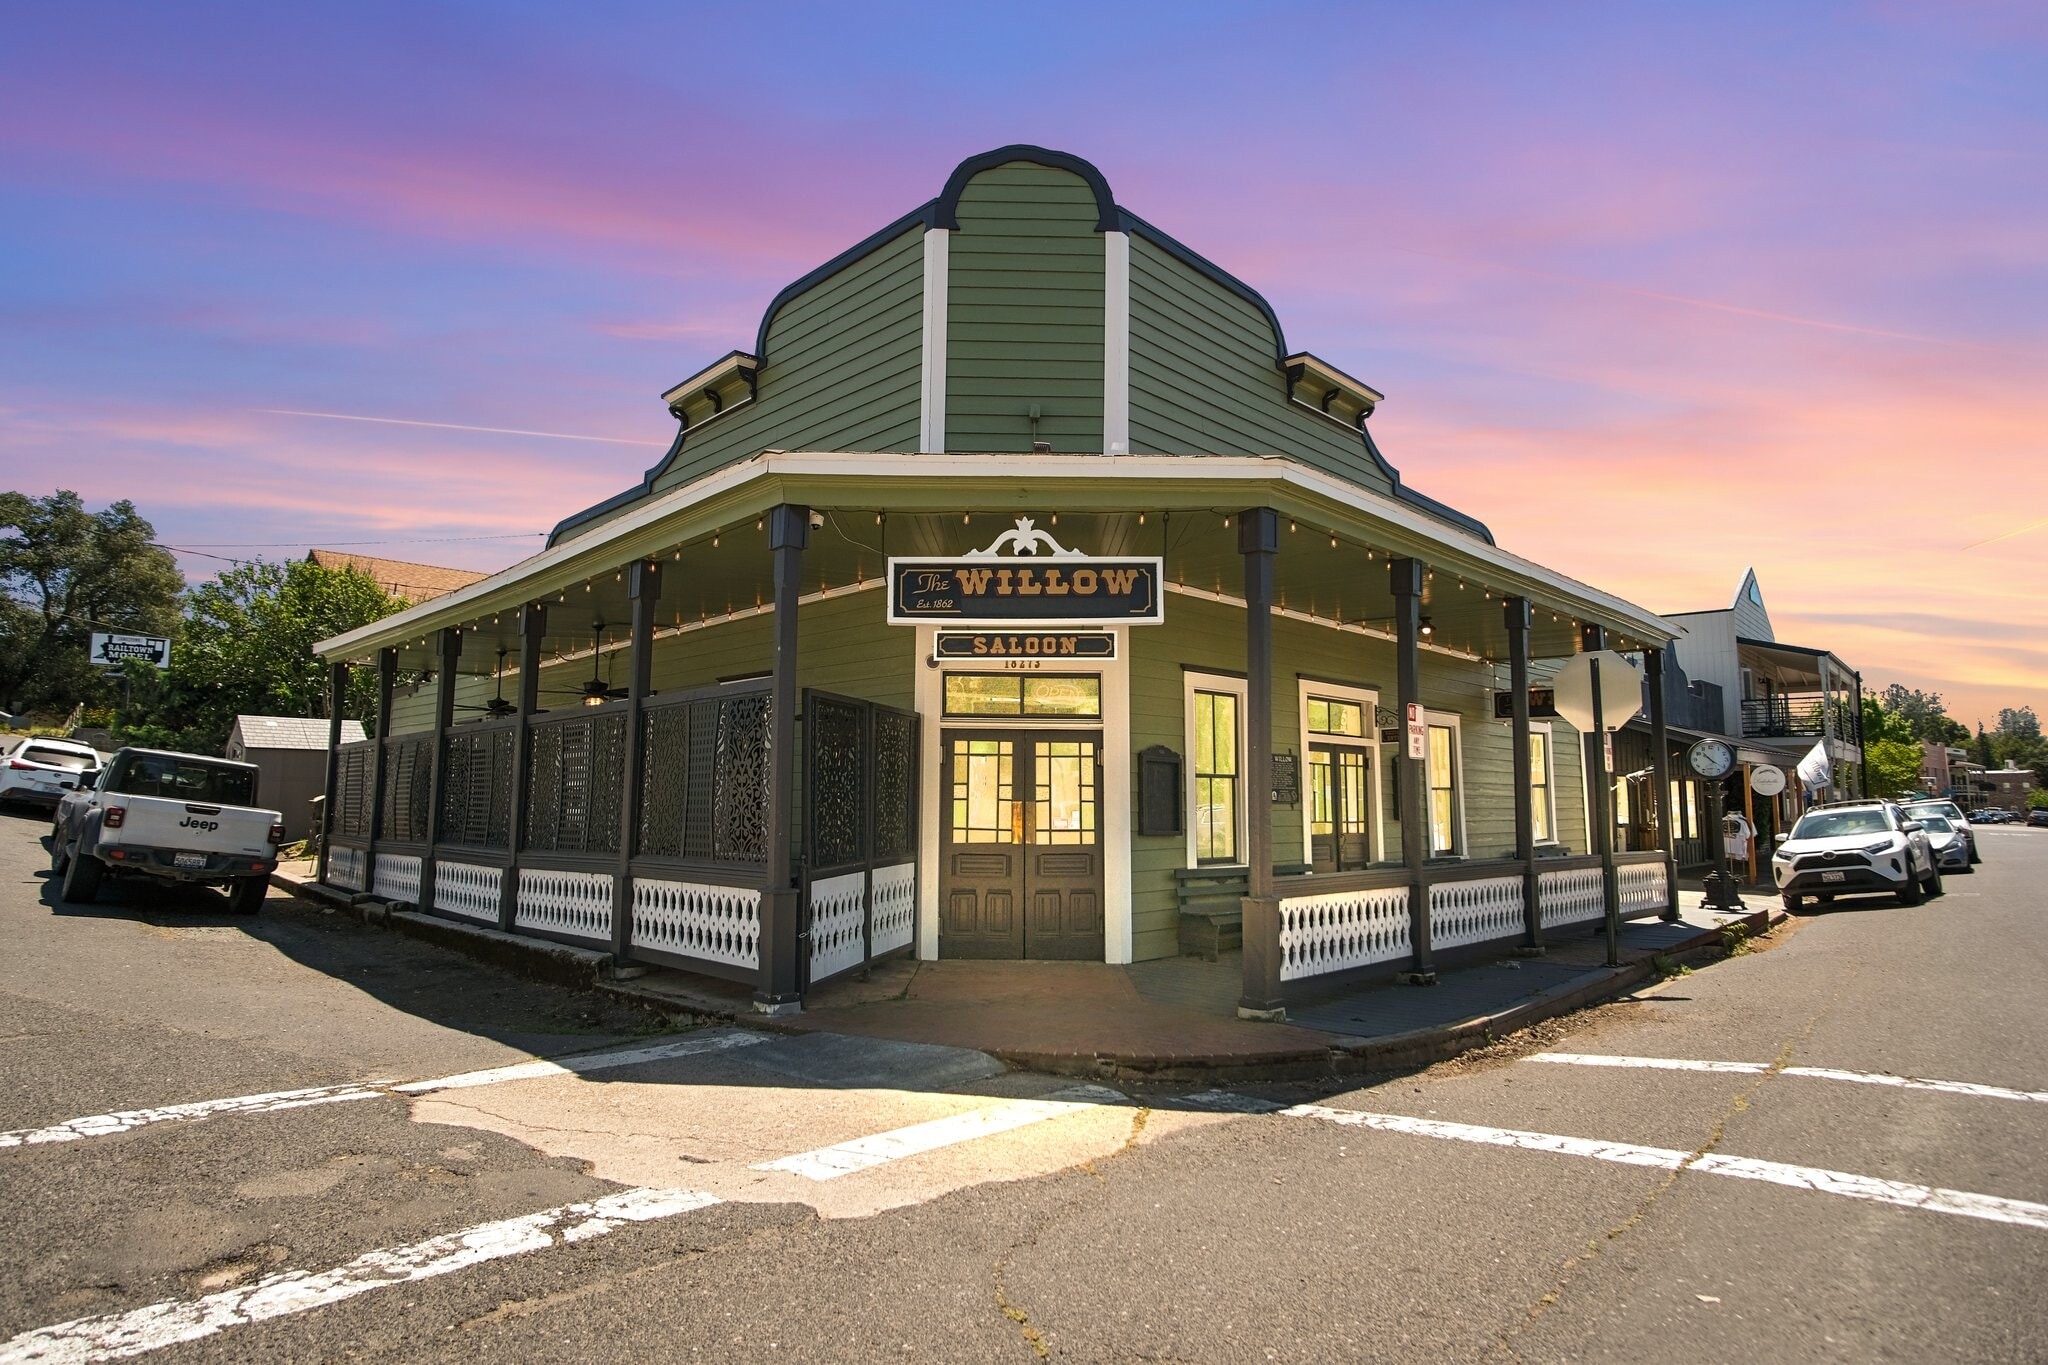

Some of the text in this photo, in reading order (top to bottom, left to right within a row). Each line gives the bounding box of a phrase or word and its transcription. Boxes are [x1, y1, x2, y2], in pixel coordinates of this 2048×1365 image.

[912, 568, 1140, 595] The WILLOW
[916, 599, 953, 608] Est. 1862
[107, 644, 154, 654] RAILTOWN
[973, 636, 1077, 655] SALOON
[108, 651, 152, 661] MOTEL
[1036, 685, 1081, 698] OPEN
[1409, 725, 1424, 735] PARKING
[179, 816, 219, 832] Jeep
